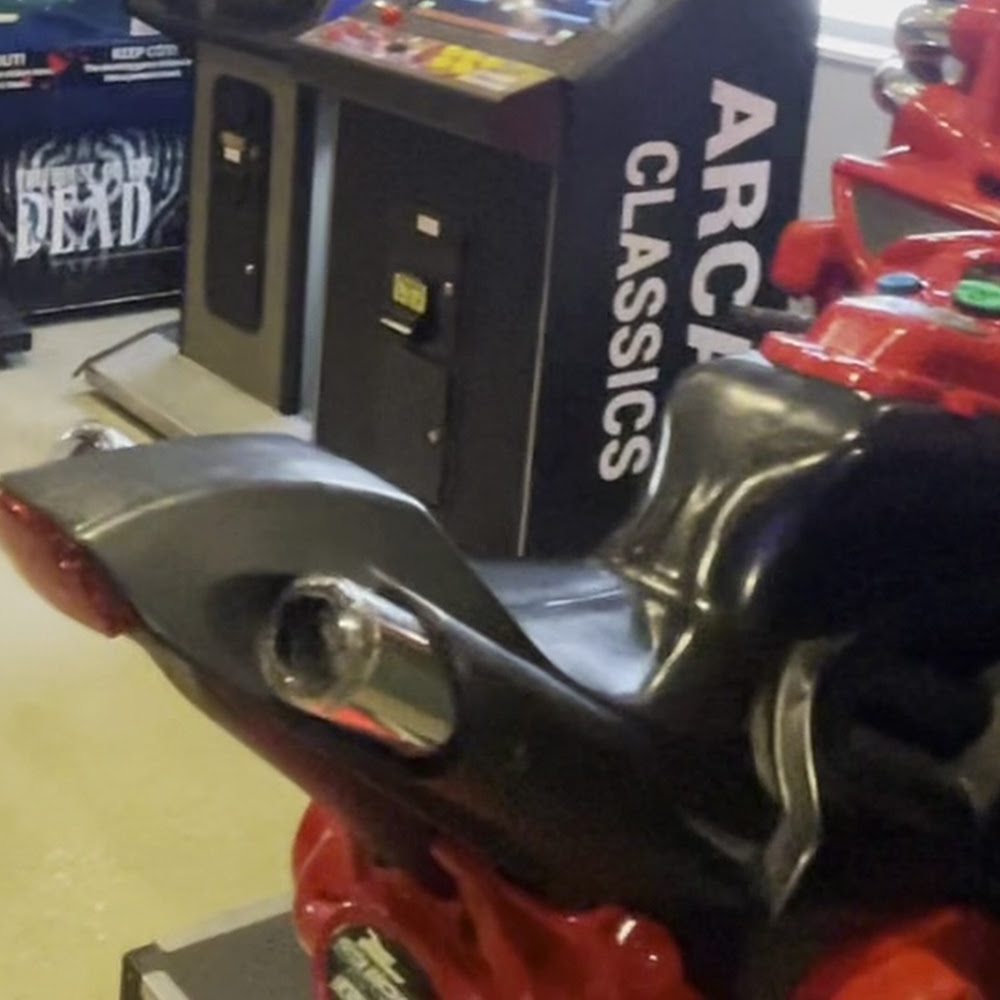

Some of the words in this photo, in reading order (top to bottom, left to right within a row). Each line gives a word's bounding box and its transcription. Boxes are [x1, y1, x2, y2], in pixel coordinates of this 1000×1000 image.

[14, 180, 152, 262] DEAD
[599, 141, 679, 482] CLASSICS
[687, 78, 778, 363] ARCA
